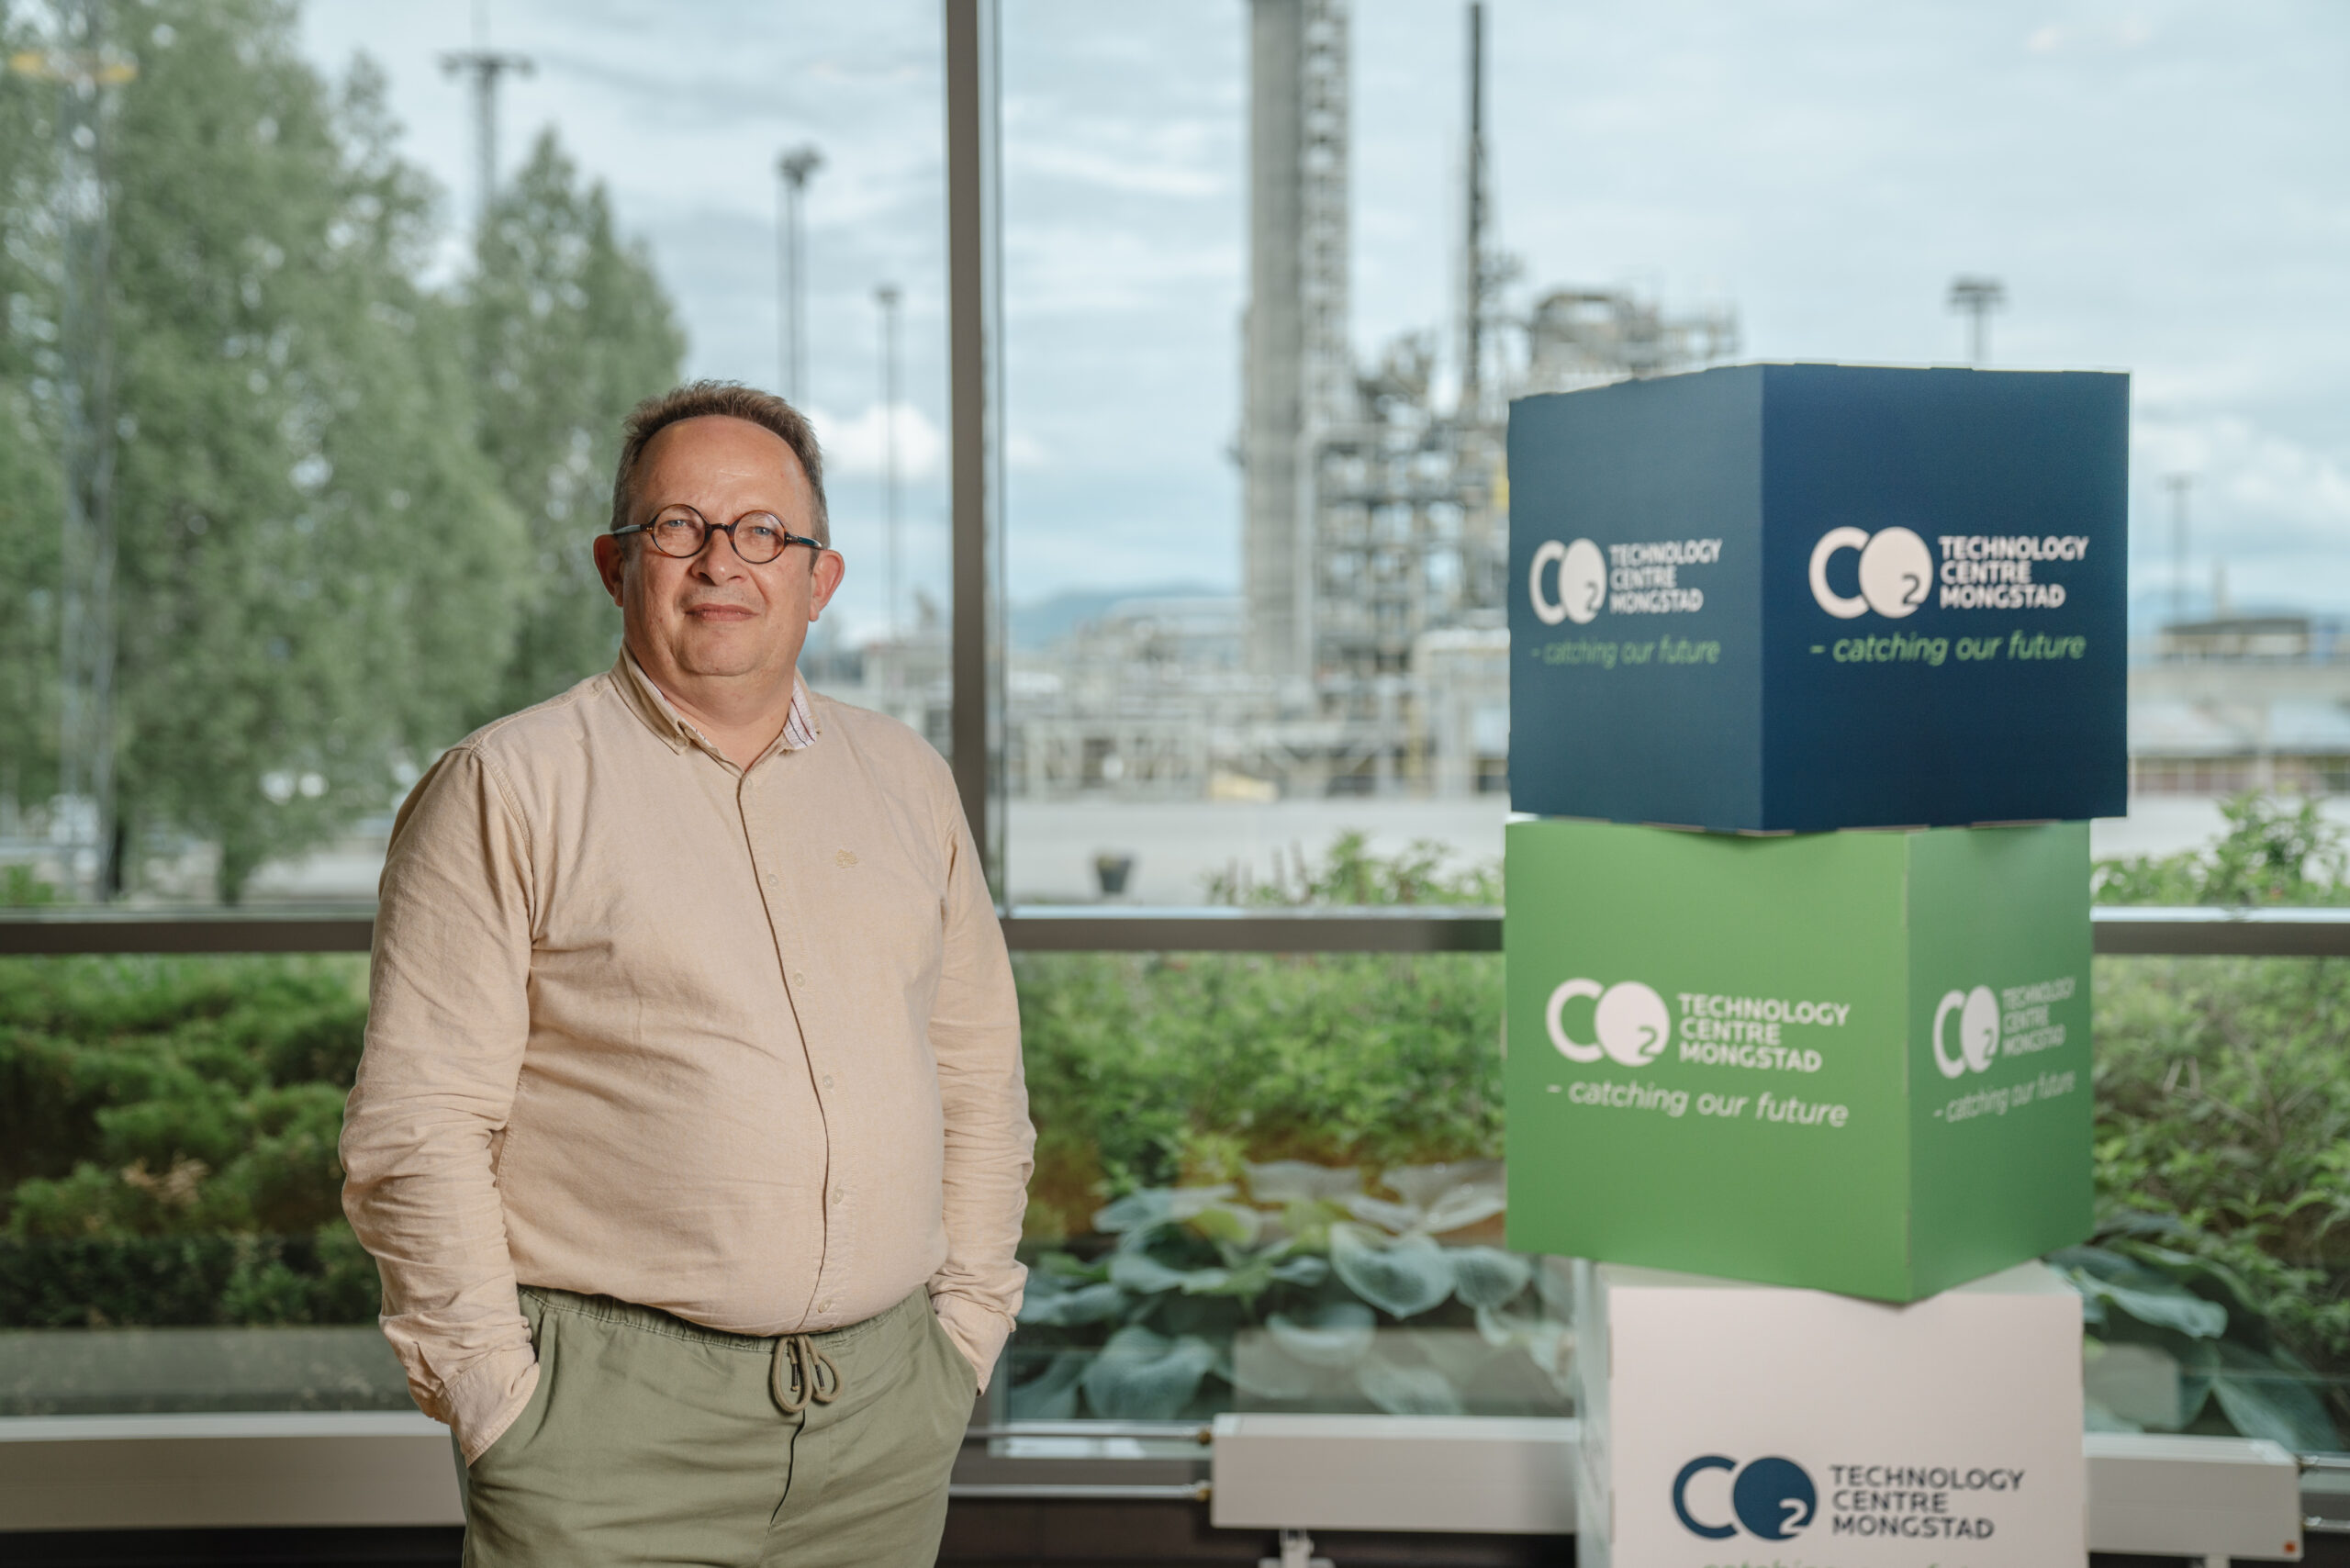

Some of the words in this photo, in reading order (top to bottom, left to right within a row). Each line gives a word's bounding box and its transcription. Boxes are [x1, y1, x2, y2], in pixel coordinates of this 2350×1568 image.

[1608, 539, 1723, 566] TECHNOLOGY
[1938, 535, 2090, 561] TECHNOLOGY
[1609, 566, 1677, 590] CENTRE
[1940, 560, 2032, 584] CENTRE
[1609, 588, 1704, 614] MONGSTAD
[1940, 584, 2065, 609] MONGSTAD
[1542, 635, 1618, 670] catching
[1620, 640, 1656, 664] our
[1658, 633, 1721, 665] future
[1832, 631, 1950, 666] catching
[1954, 635, 2003, 660] our
[2007, 629, 2087, 660] future
[1677, 992, 1851, 1026] TECHNOLOGY
[1679, 1017, 1781, 1046] CENTRE
[1679, 1041, 1823, 1073] MONGSTAD
[1568, 1080, 1690, 1117] catching
[1696, 1092, 1750, 1117] our
[1755, 1091, 1849, 1128] future
[1829, 1464, 2025, 1491] TECHNOLOGY
[1831, 1491, 1949, 1513] CENTRE
[1831, 1516, 1996, 1540] MONGSTAD
